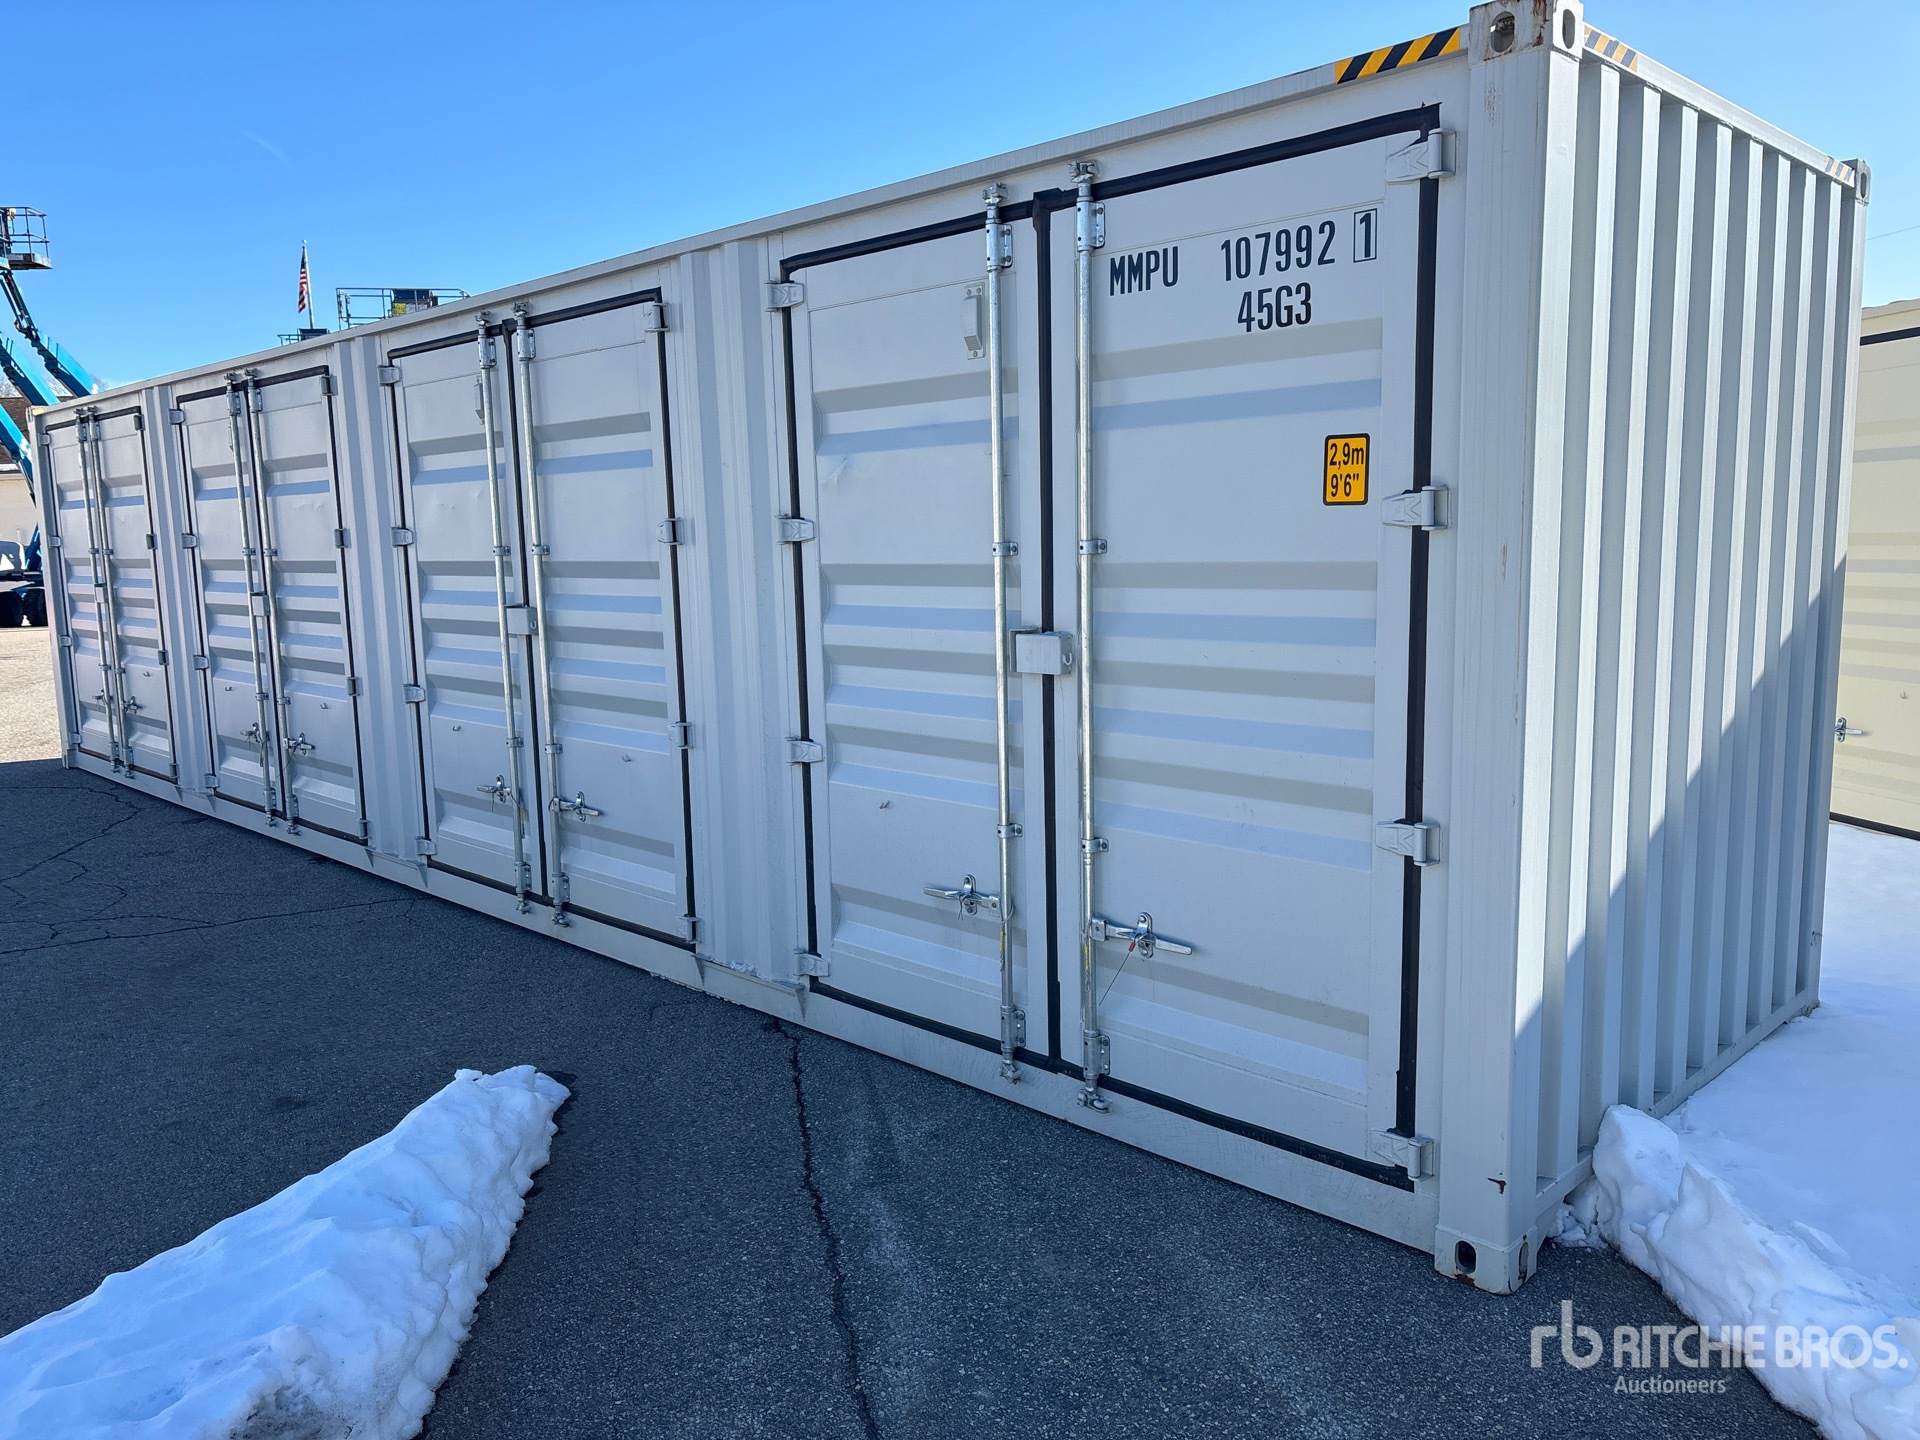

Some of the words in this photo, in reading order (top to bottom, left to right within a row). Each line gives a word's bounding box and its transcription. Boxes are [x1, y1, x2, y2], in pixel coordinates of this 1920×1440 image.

[1109, 246, 1179, 296] MMPU
[1221, 220, 1337, 282] 107992
[1358, 211, 1374, 260] 1
[1237, 282, 1313, 333] 45G3
